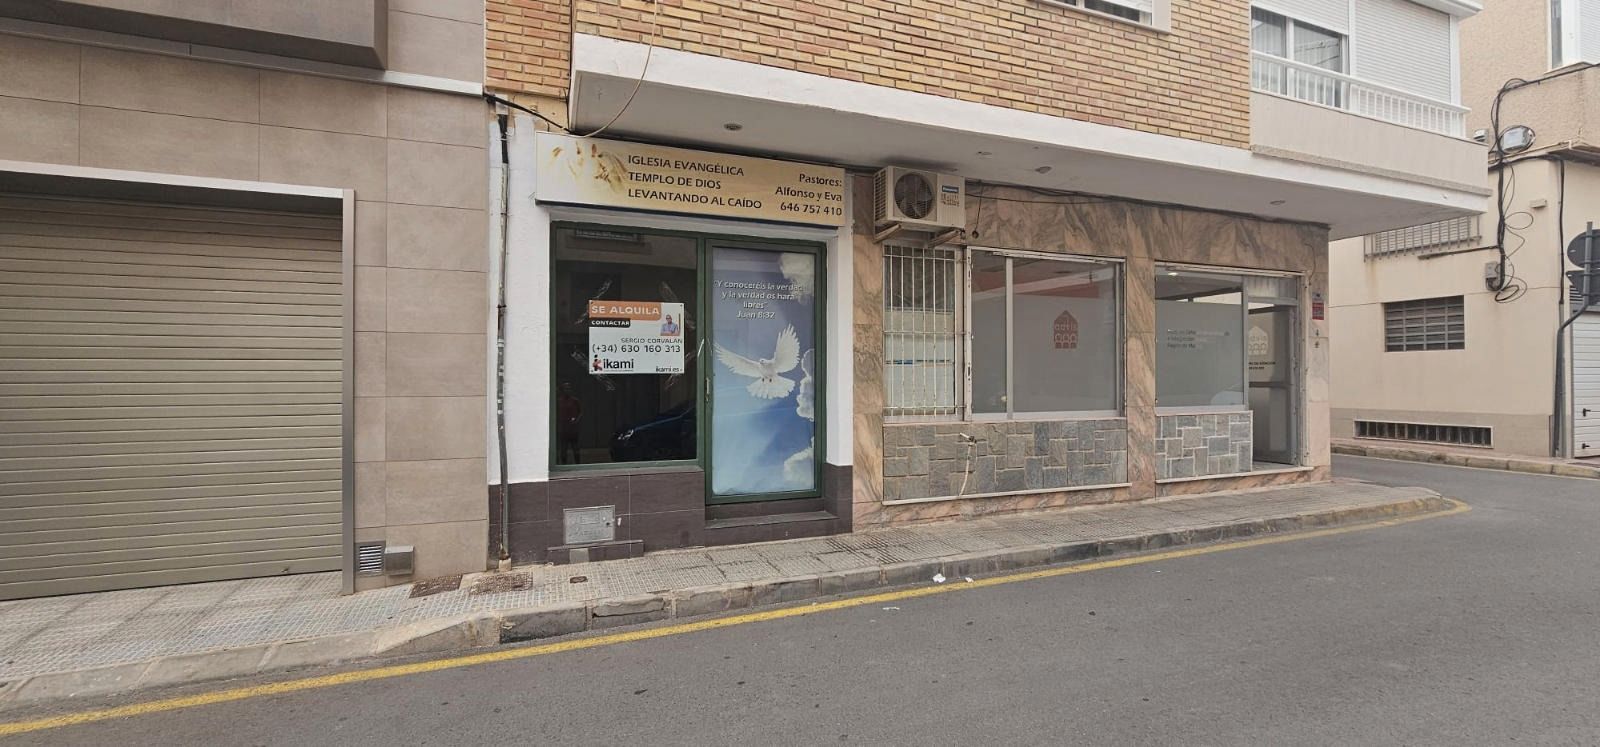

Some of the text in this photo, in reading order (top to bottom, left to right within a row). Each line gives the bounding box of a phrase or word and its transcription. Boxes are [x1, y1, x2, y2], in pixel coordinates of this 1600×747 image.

[628, 154, 744, 176] IGLESIA EVANGÉLICA
[628, 172, 721, 190] TEMPLO DE DIOS
[799, 173, 842, 187] Pastores:
[628, 188, 762, 209] LEVANTANDO AL CAÍDO
[775, 186, 842, 202] Alfonso y Eva
[780, 202, 842, 216] 646 757 410
[722, 291, 729, 299] y
[729, 290, 737, 298] la
[738, 291, 765, 300] verdad
[591, 305, 660, 315] SE ALQUILA
[736, 310, 756, 319] Juan
[592, 344, 681, 353] (+34) 630 160 313
[603, 358, 635, 369] ikami
